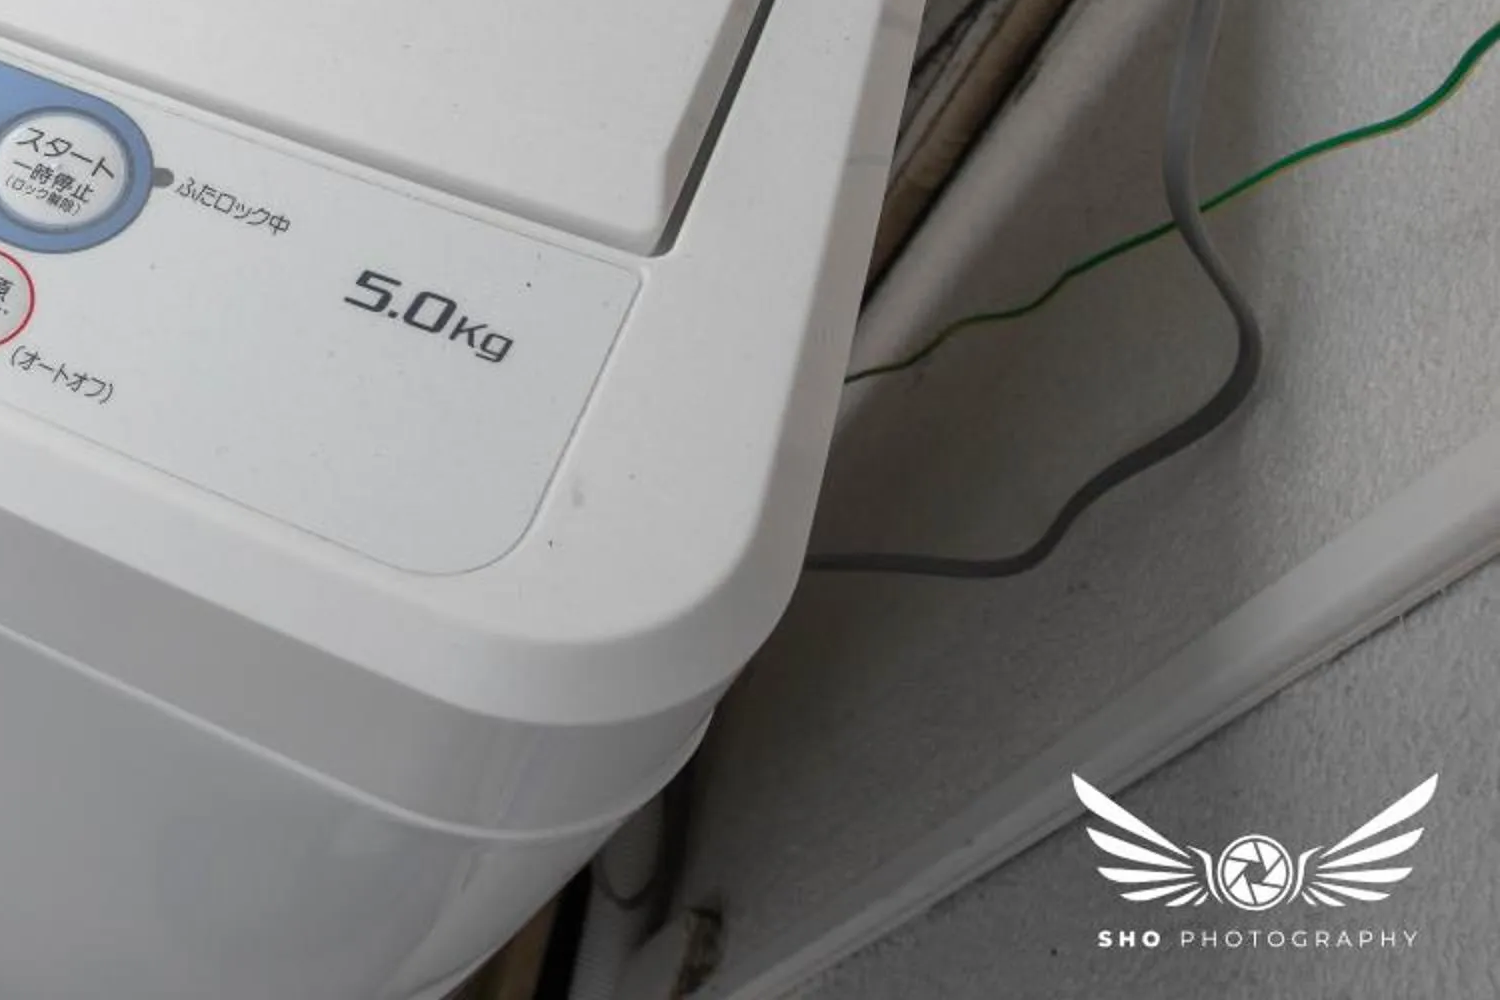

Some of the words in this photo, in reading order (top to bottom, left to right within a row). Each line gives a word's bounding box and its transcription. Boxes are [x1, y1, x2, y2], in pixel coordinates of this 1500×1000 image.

[12, 159, 95, 204] 一時停止
[16, 126, 115, 180] スタート
[175, 176, 291, 236] ふたロック中
[11, 345, 114, 405] (オートオフ)
